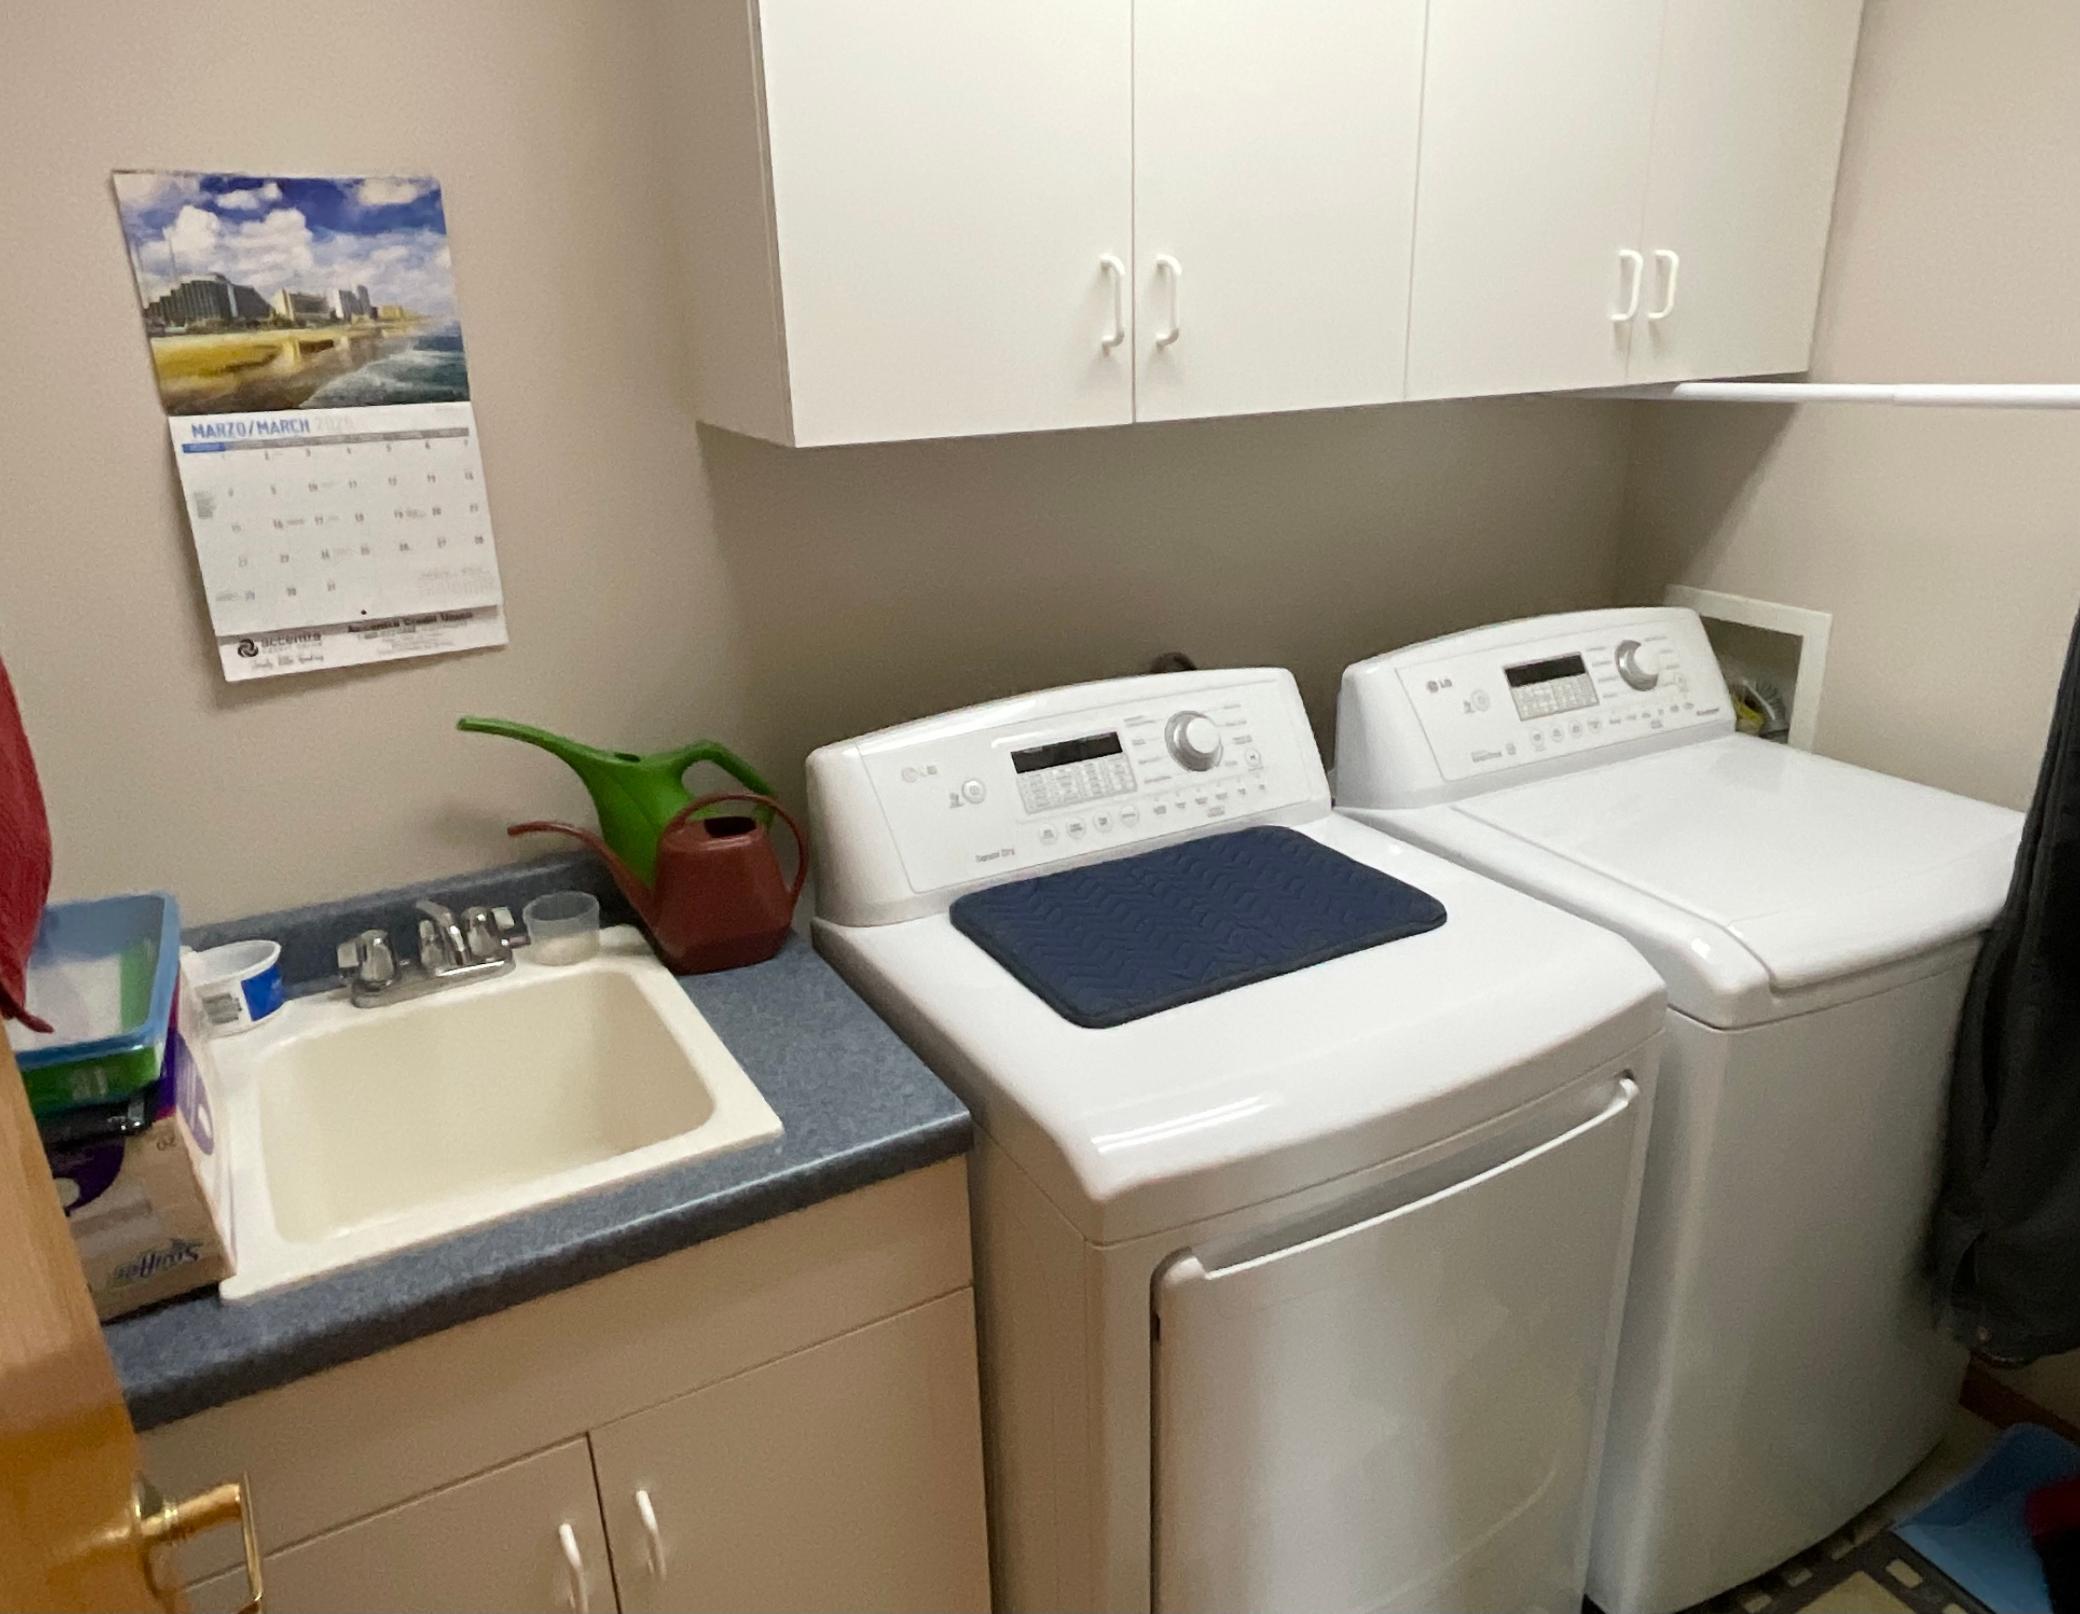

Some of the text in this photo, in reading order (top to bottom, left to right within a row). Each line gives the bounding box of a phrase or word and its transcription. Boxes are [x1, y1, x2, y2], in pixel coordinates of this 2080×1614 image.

[191, 418, 311, 439] MARZO/MARCH
[1440, 677, 1453, 689] LG
[113, 1242, 200, 1282] Swiffer
